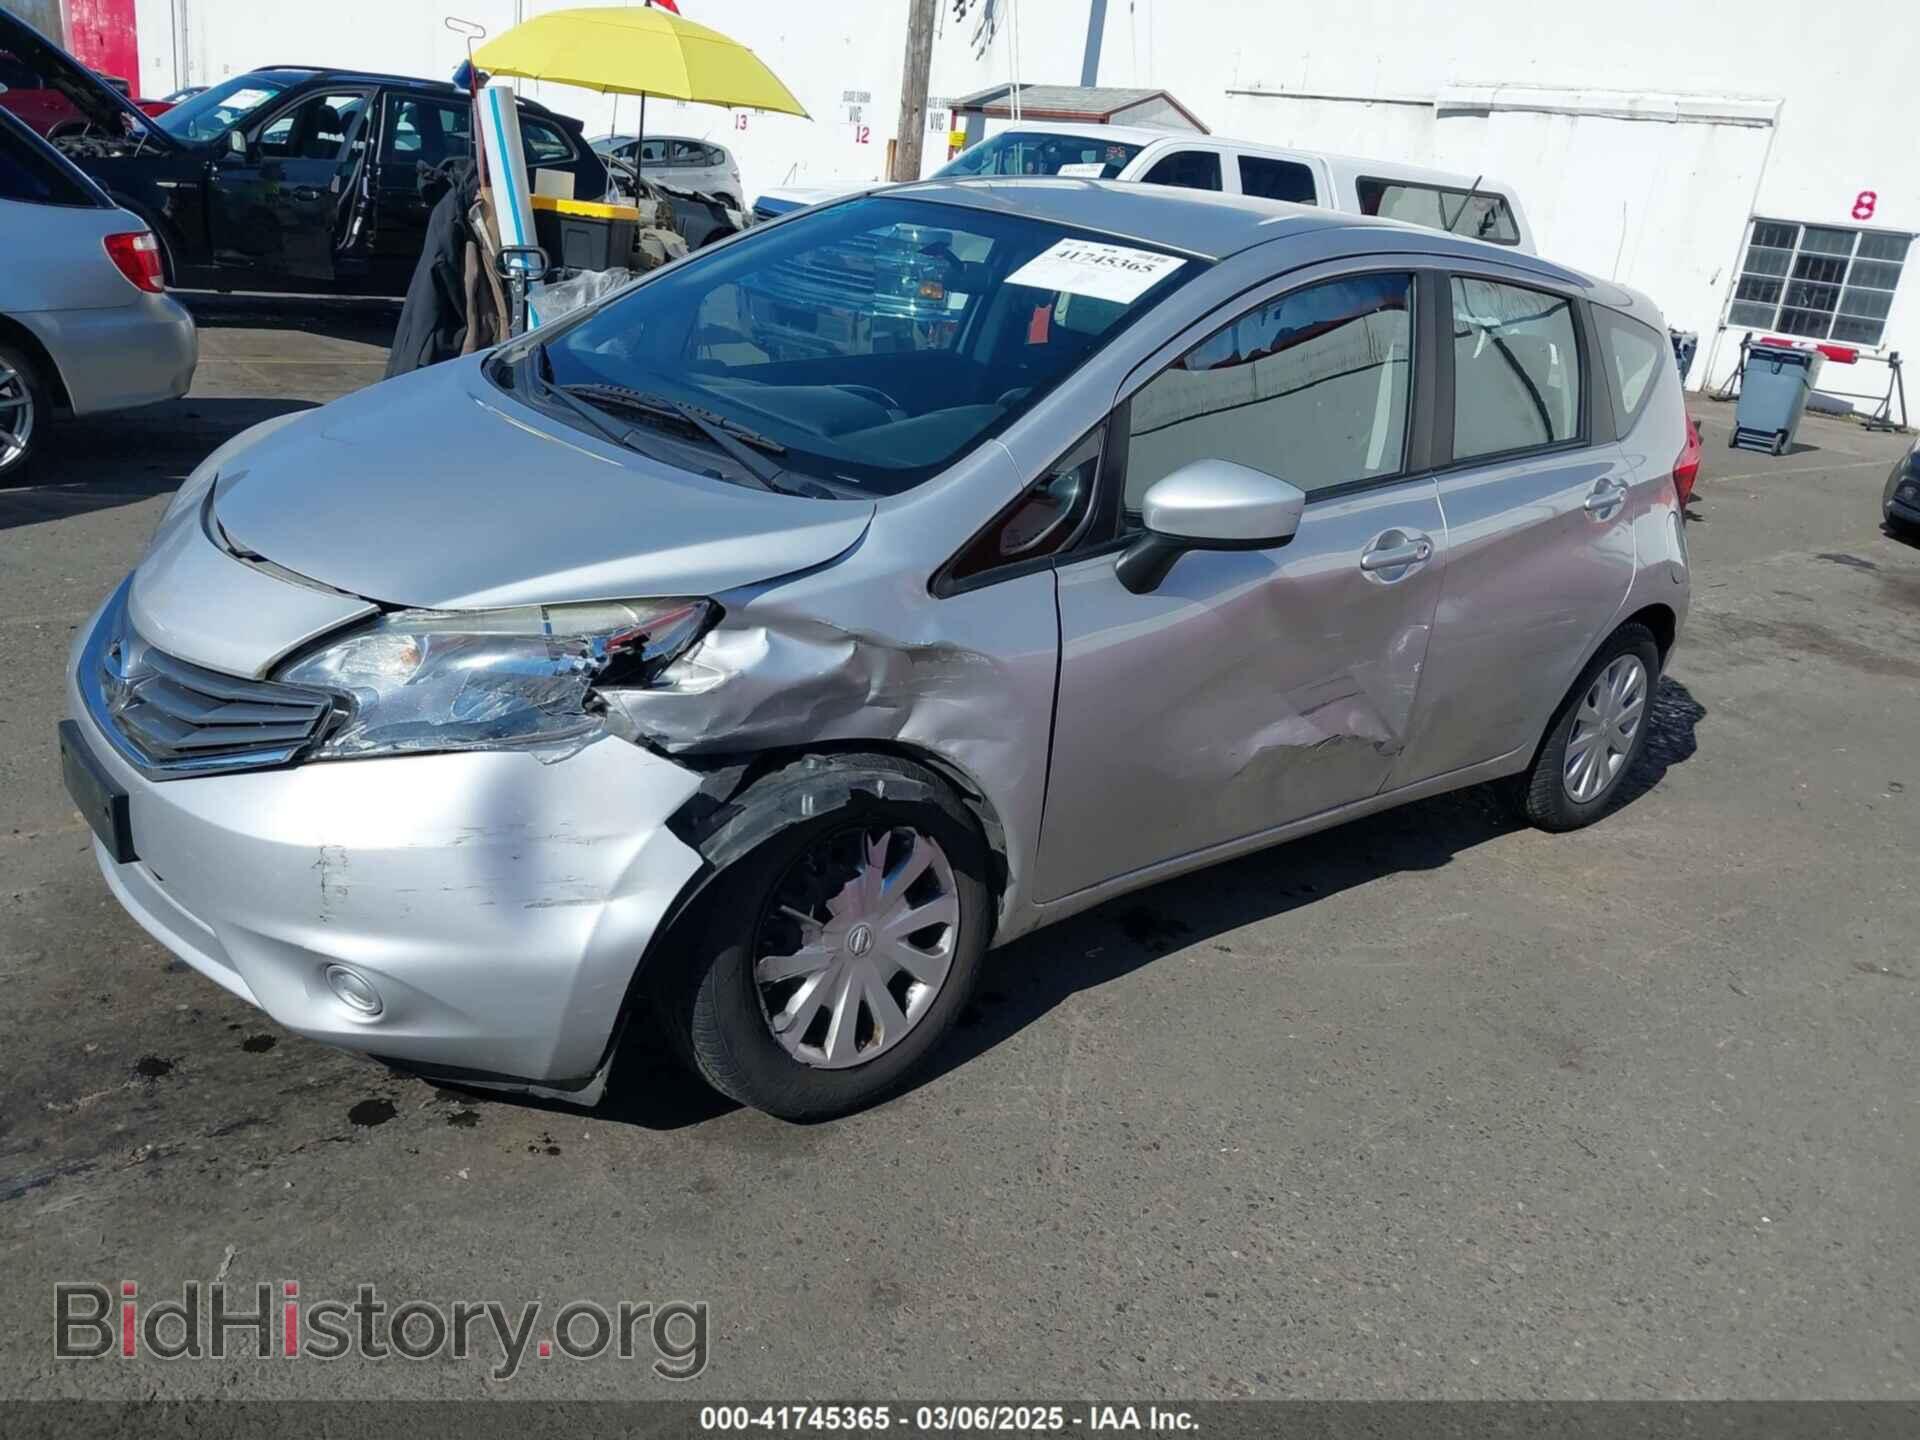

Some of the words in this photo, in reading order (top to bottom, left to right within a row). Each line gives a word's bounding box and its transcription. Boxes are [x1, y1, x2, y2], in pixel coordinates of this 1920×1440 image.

[735, 113, 748, 130] 13
[930, 112, 944, 130] VIC
[856, 126, 870, 144] 12
[1852, 190, 1877, 220] 8
[1056, 250, 1157, 273] 41745365
